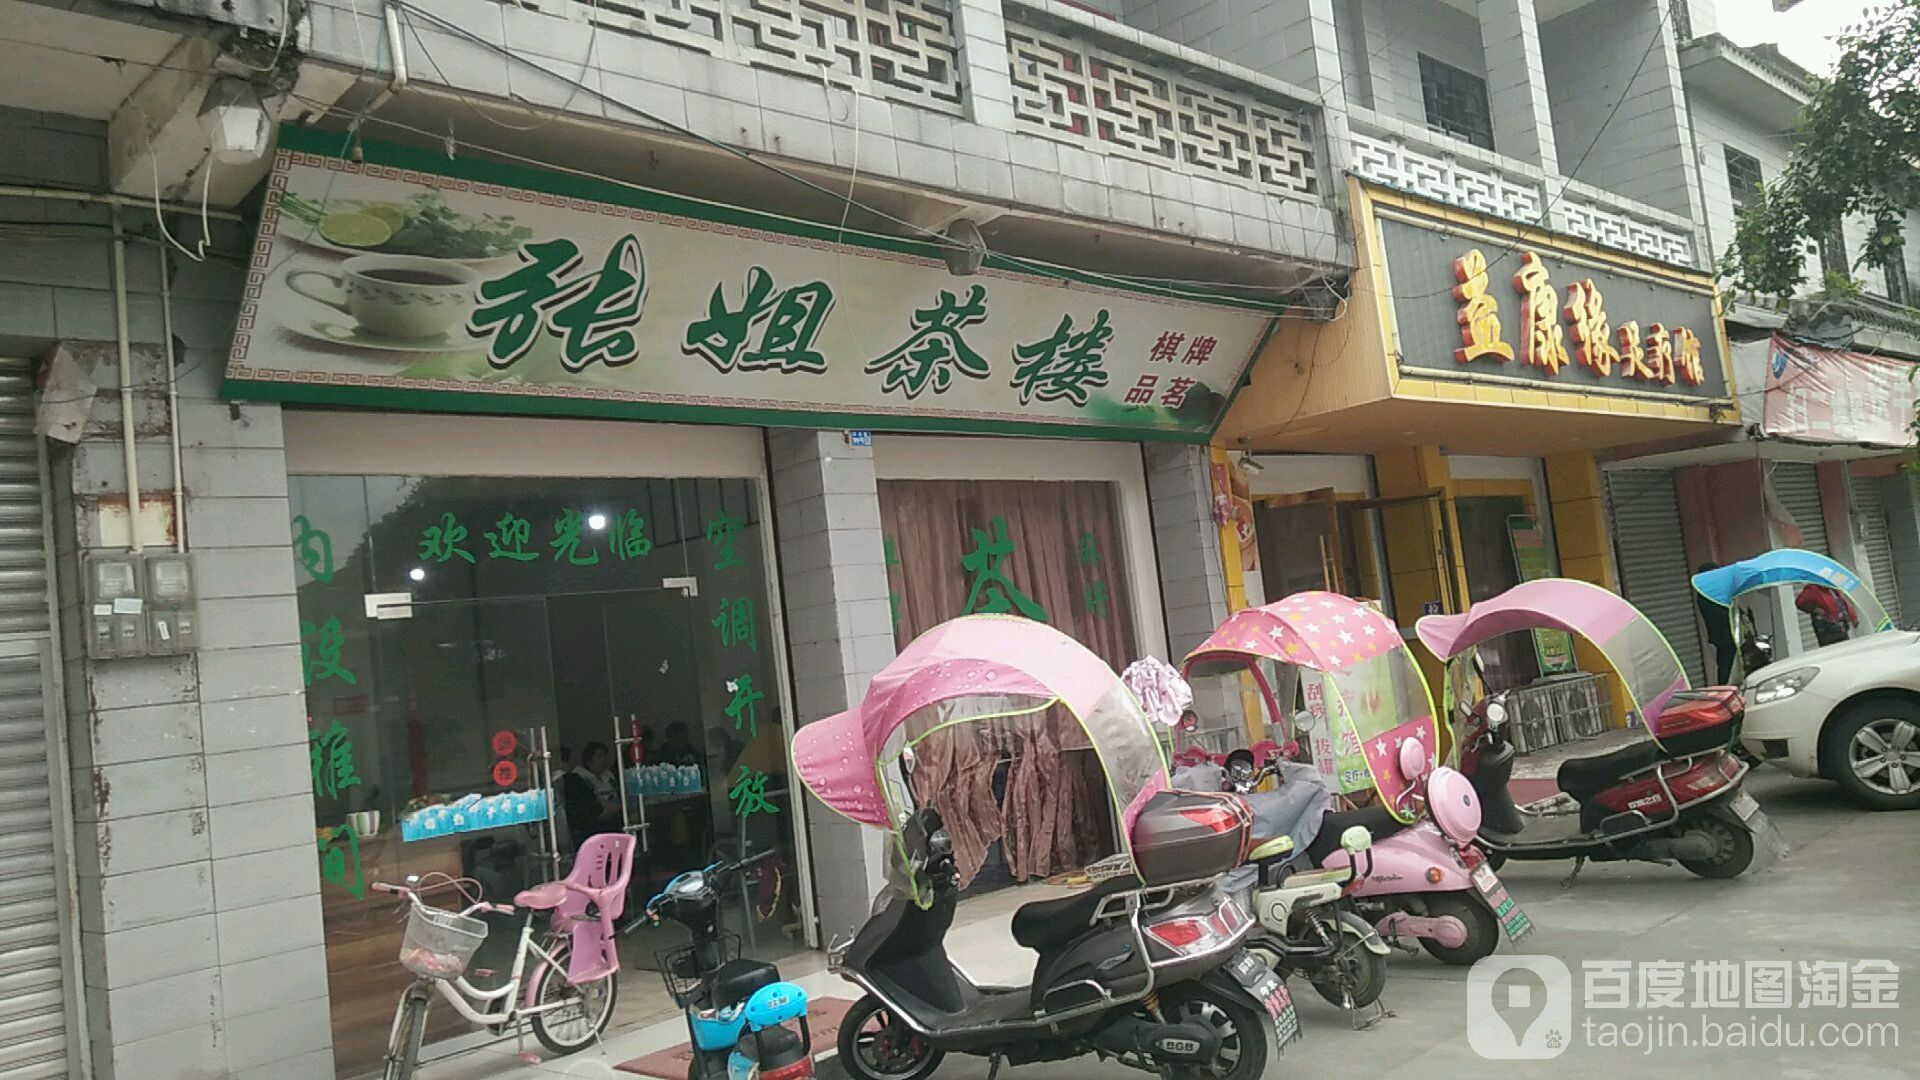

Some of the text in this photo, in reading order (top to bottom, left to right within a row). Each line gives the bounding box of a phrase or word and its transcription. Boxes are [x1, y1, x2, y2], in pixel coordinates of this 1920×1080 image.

[468, 233, 1114, 408] 张姐茶楼
[1150, 331, 1218, 367] 棋牌
[1123, 374, 1191, 408] 品茗
[418, 507, 653, 567] 欢迎光临
[705, 510, 781, 819] 空调开放
[1166, 1041, 1194, 1051] BGB
